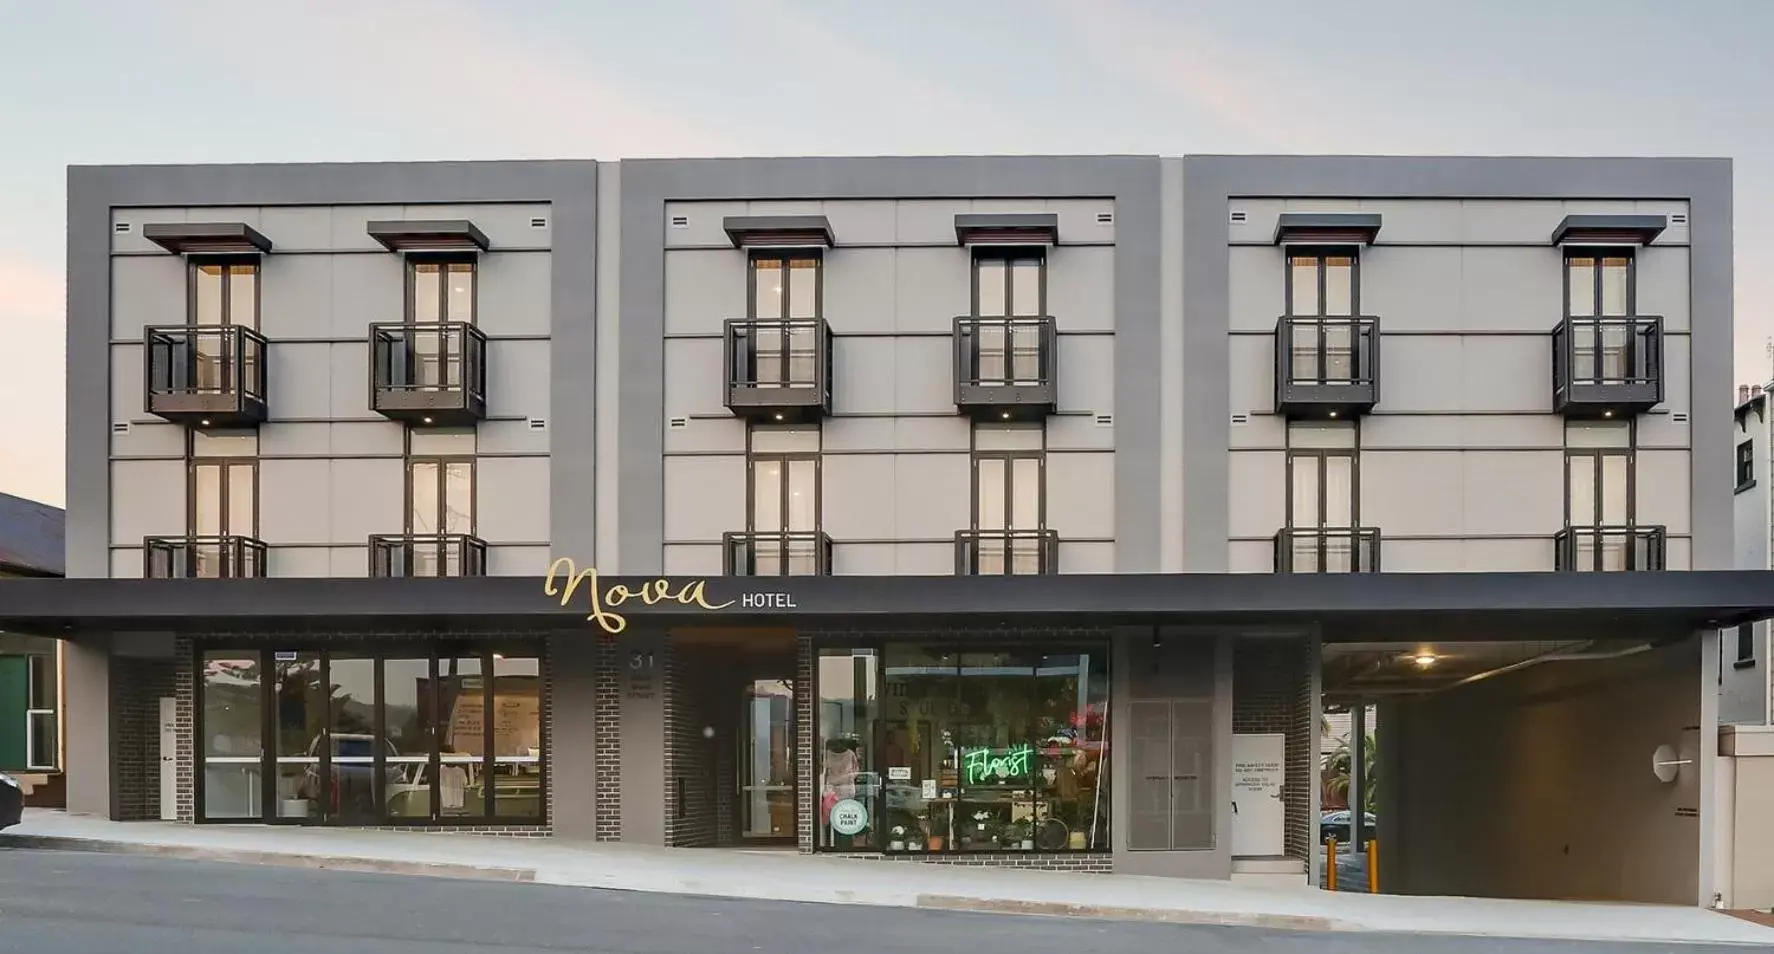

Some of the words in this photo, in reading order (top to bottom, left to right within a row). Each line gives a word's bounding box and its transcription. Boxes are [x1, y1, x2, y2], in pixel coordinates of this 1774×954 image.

[545, 557, 736, 633] Nova
[742, 593, 797, 608] HOTEL
[630, 651, 653, 669] 31
[965, 743, 1034, 785] Florist
